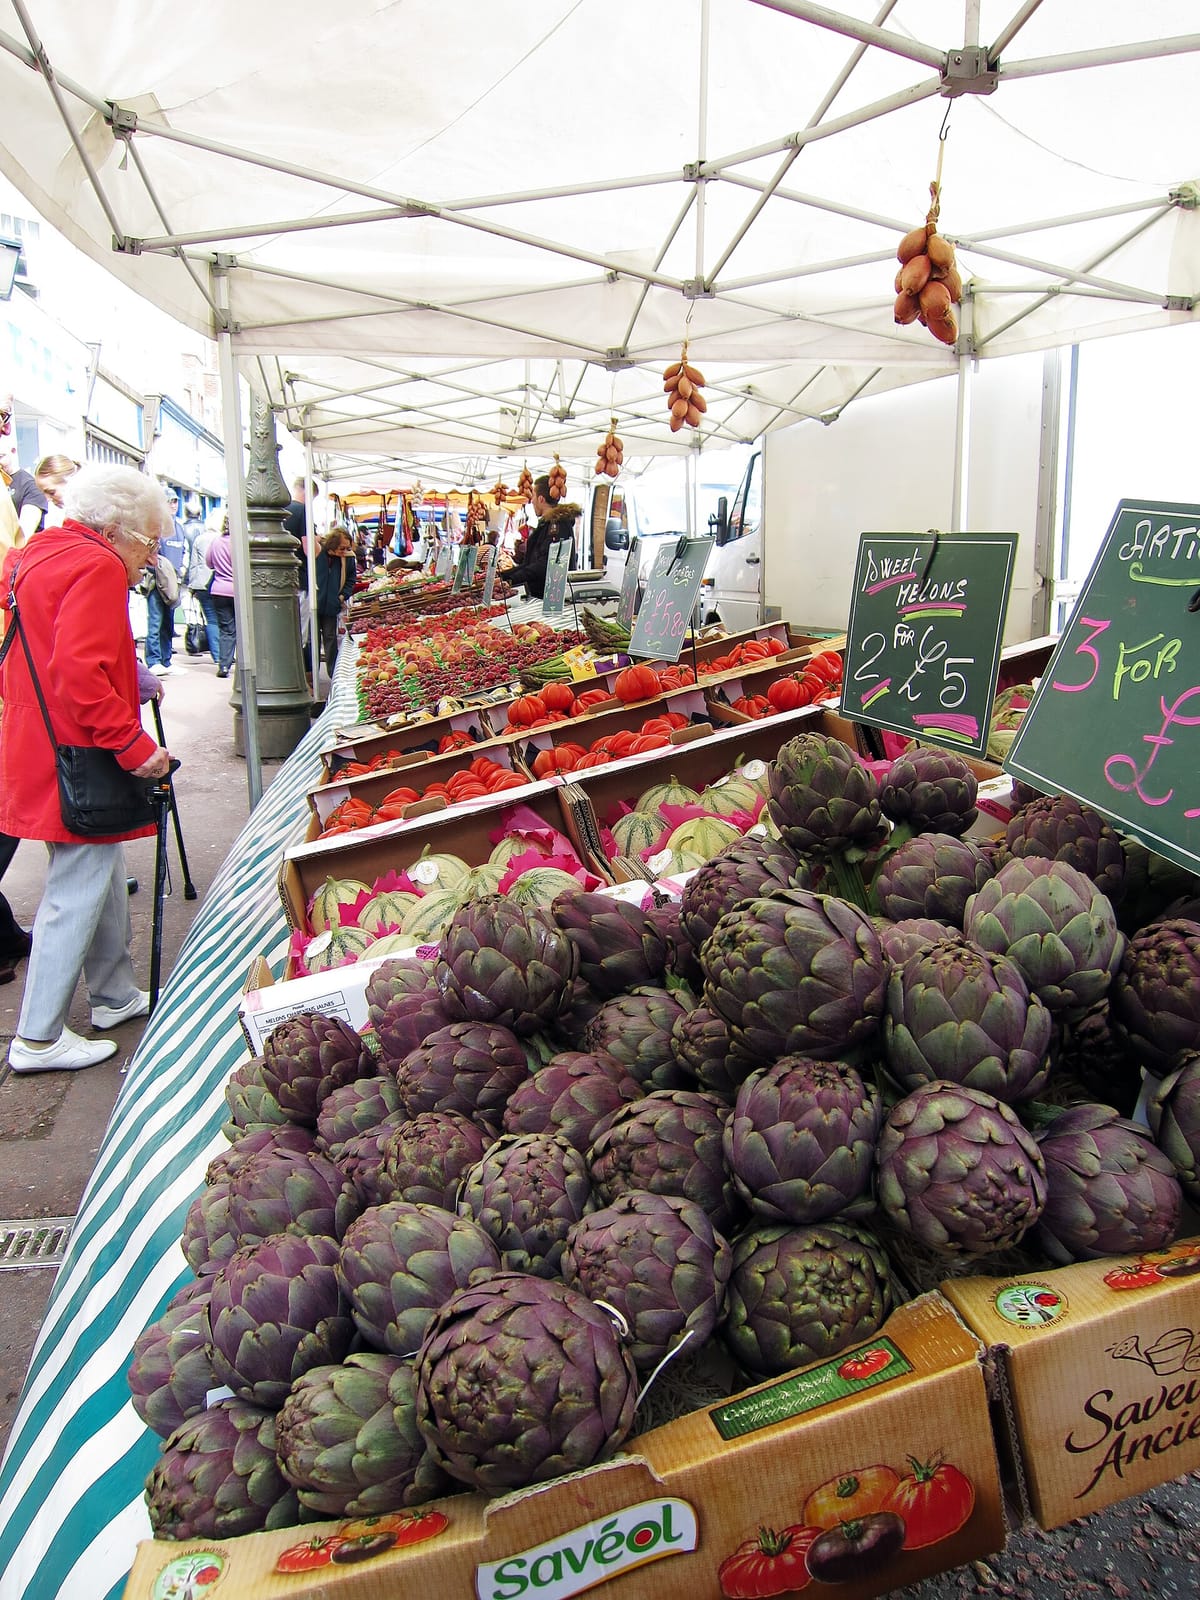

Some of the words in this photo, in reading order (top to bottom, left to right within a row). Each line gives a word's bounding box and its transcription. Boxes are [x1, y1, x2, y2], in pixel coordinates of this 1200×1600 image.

[1118, 519, 1200, 561] ARTI
[861, 548, 922, 592] SWEET
[895, 577, 968, 606] MELONS
[853, 632, 887, 682] 2
[893, 623, 915, 650] FOR
[1052, 616, 1112, 693] 3
[1112, 632, 1182, 700] FOR
[265, 1014, 287, 1024] MELONS
[1039, 1309, 1070, 1330] cultures
[493, 1503, 683, 1600] Savéol
